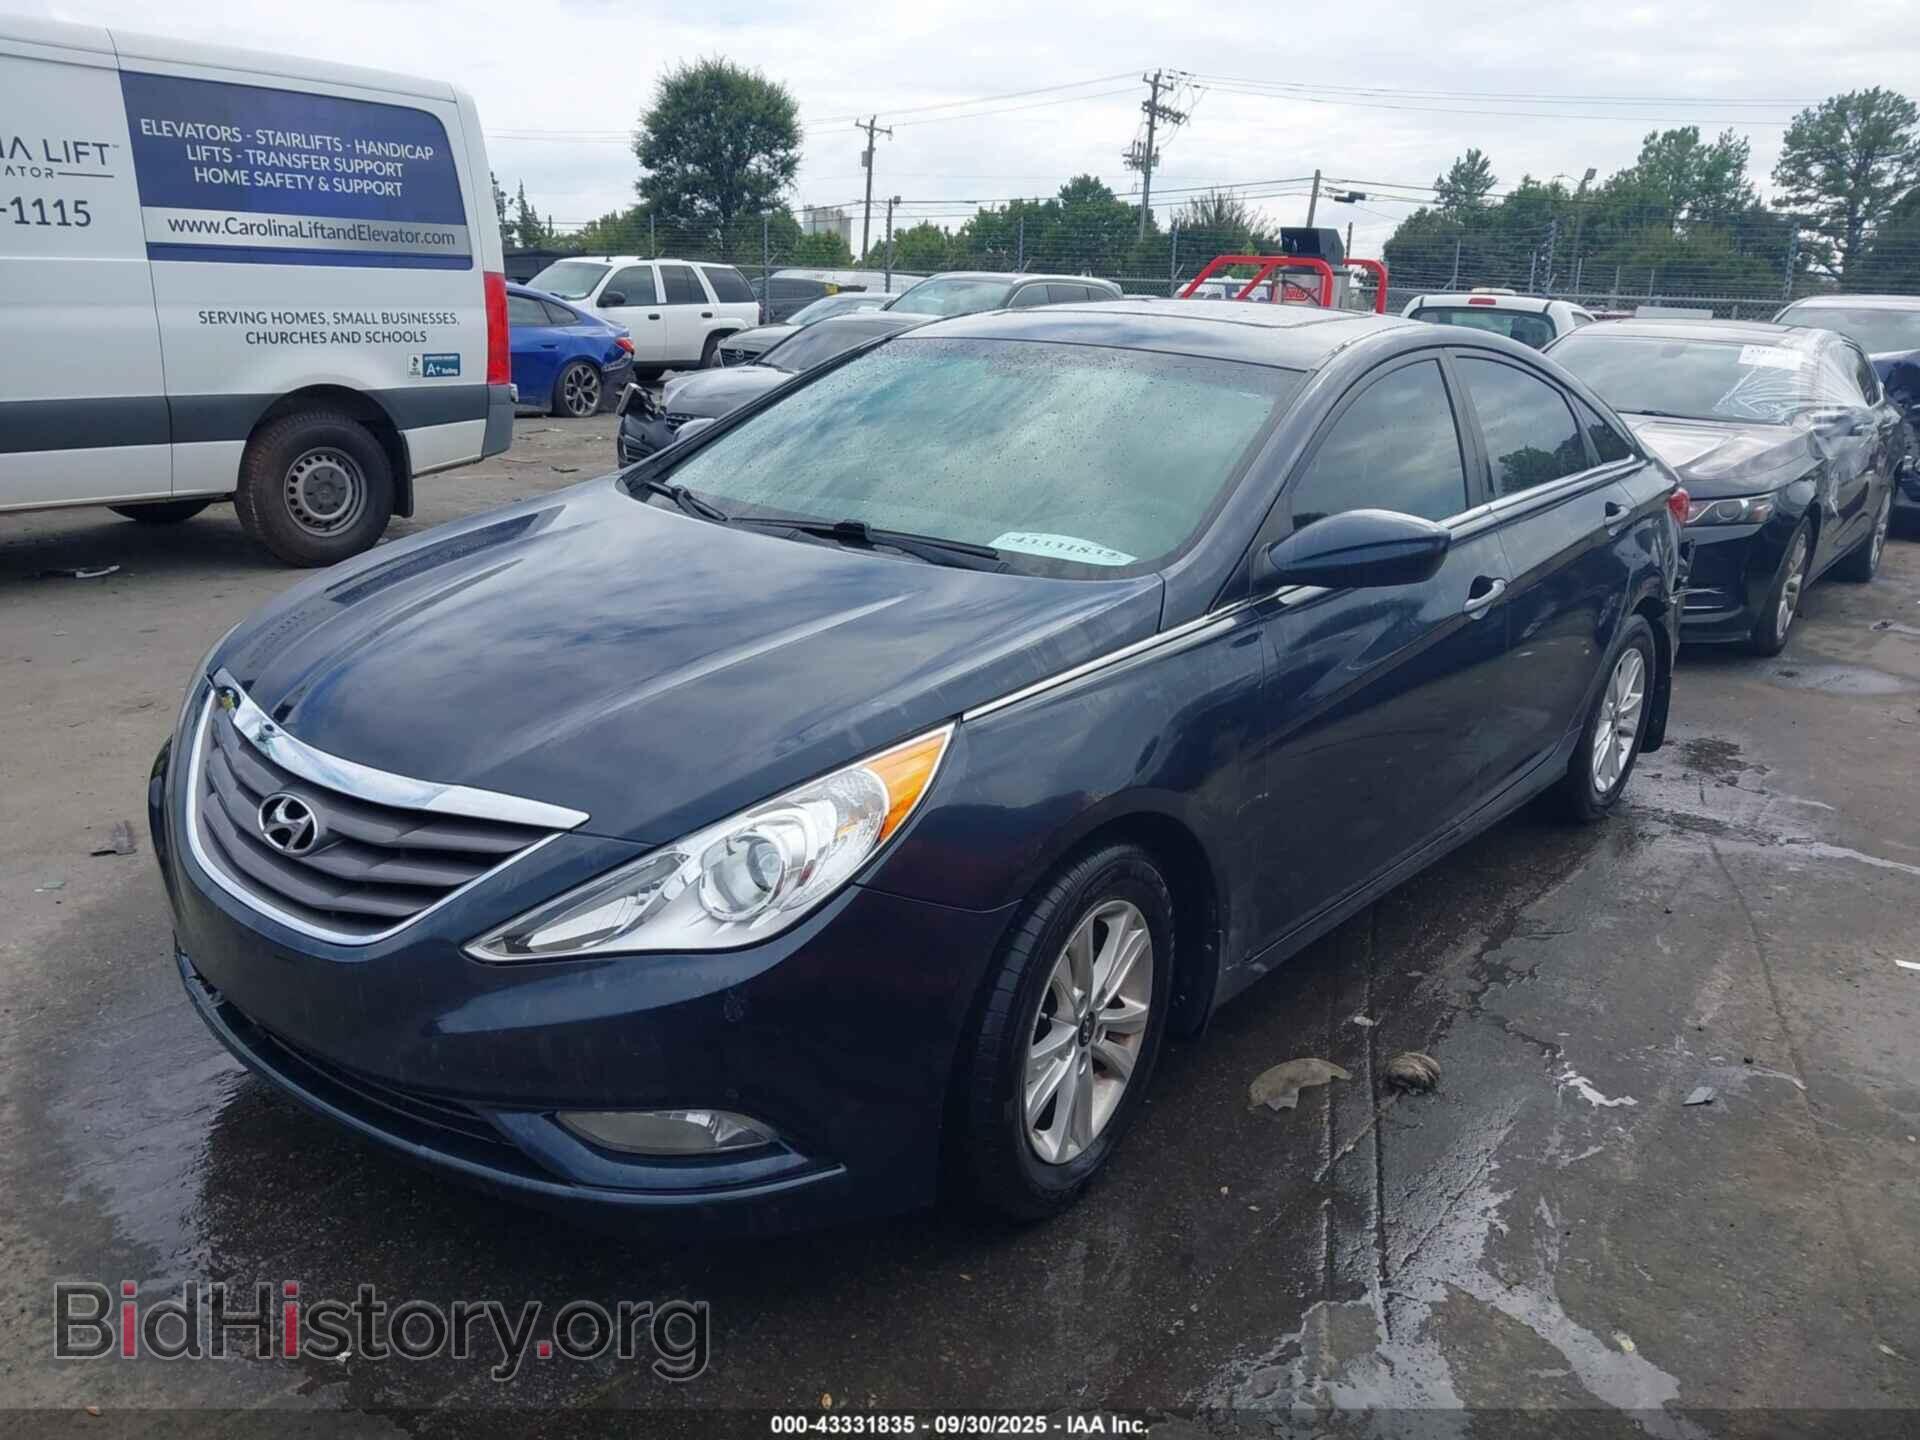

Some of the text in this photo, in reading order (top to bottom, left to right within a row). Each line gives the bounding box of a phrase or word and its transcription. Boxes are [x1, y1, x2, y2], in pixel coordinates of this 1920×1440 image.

[42, 139, 110, 165] LIFT
[140, 118, 242, 143] ELEVATORS
[256, 129, 343, 152] STAIRLIFTS
[355, 139, 434, 161] HANDICAP
[186, 144, 232, 163] LIFTS
[245, 149, 330, 171] TRANSFER
[333, 156, 403, 177] SUPPORT
[194, 167, 403, 197] HOME SAFETY & SUPPORT
[168, 217, 455, 245] www.CarolinaLiftandElevator.com
[198, 310, 460, 326] SERVING HOMES, SMALL BUSINESSES,
[245, 330, 427, 345] CHURCHES AND SCHOOLS
